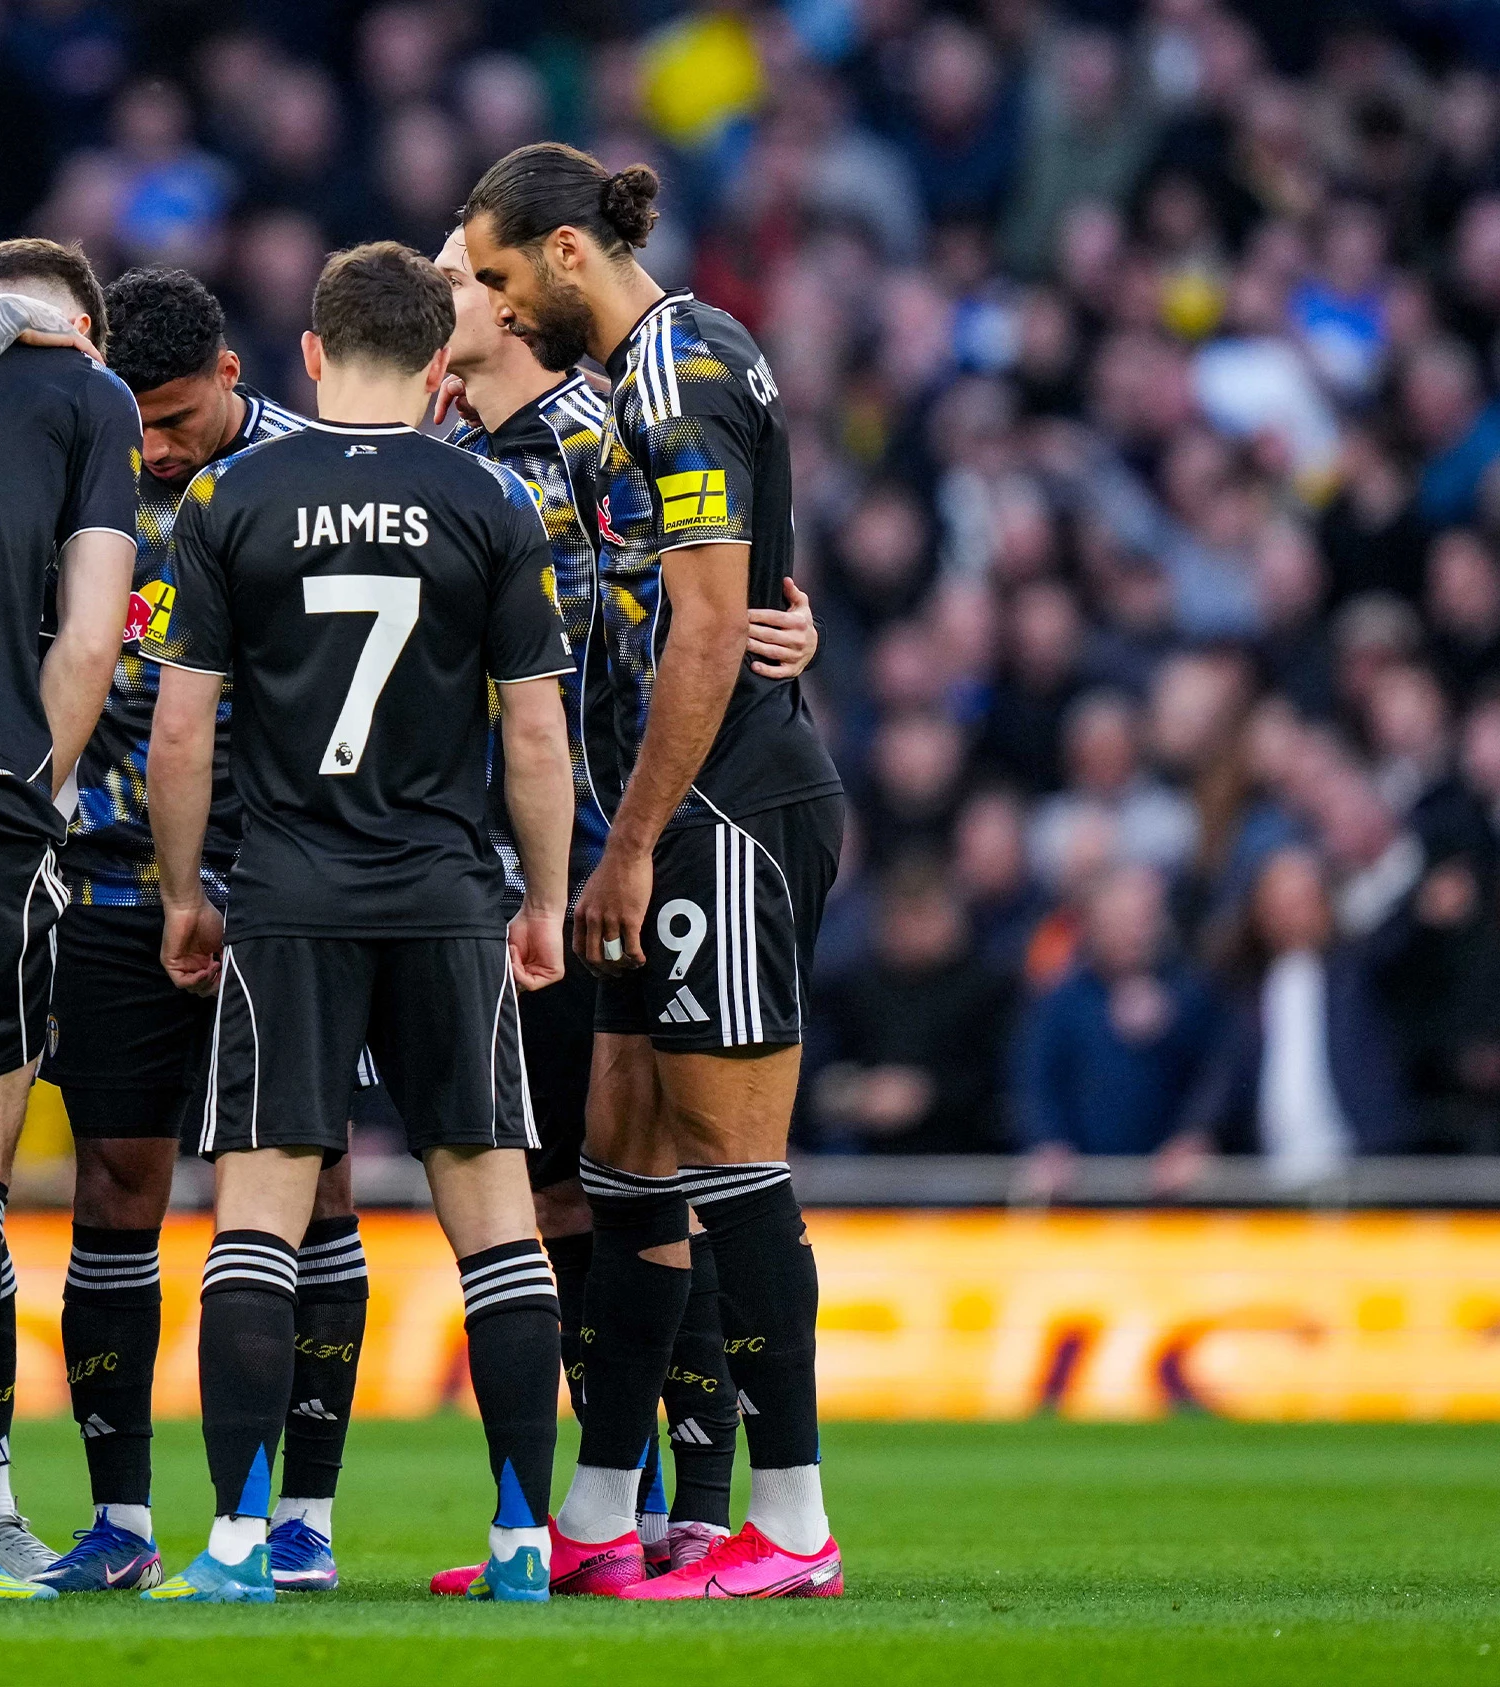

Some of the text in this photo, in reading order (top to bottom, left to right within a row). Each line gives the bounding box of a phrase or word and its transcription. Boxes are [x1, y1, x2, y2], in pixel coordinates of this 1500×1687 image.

[293, 502, 430, 549] JAMES
[665, 515, 727, 530] PARIMATCH
[302, 574, 422, 776] 7
[656, 898, 708, 980] 9
[67, 1351, 119, 1384] UFC
